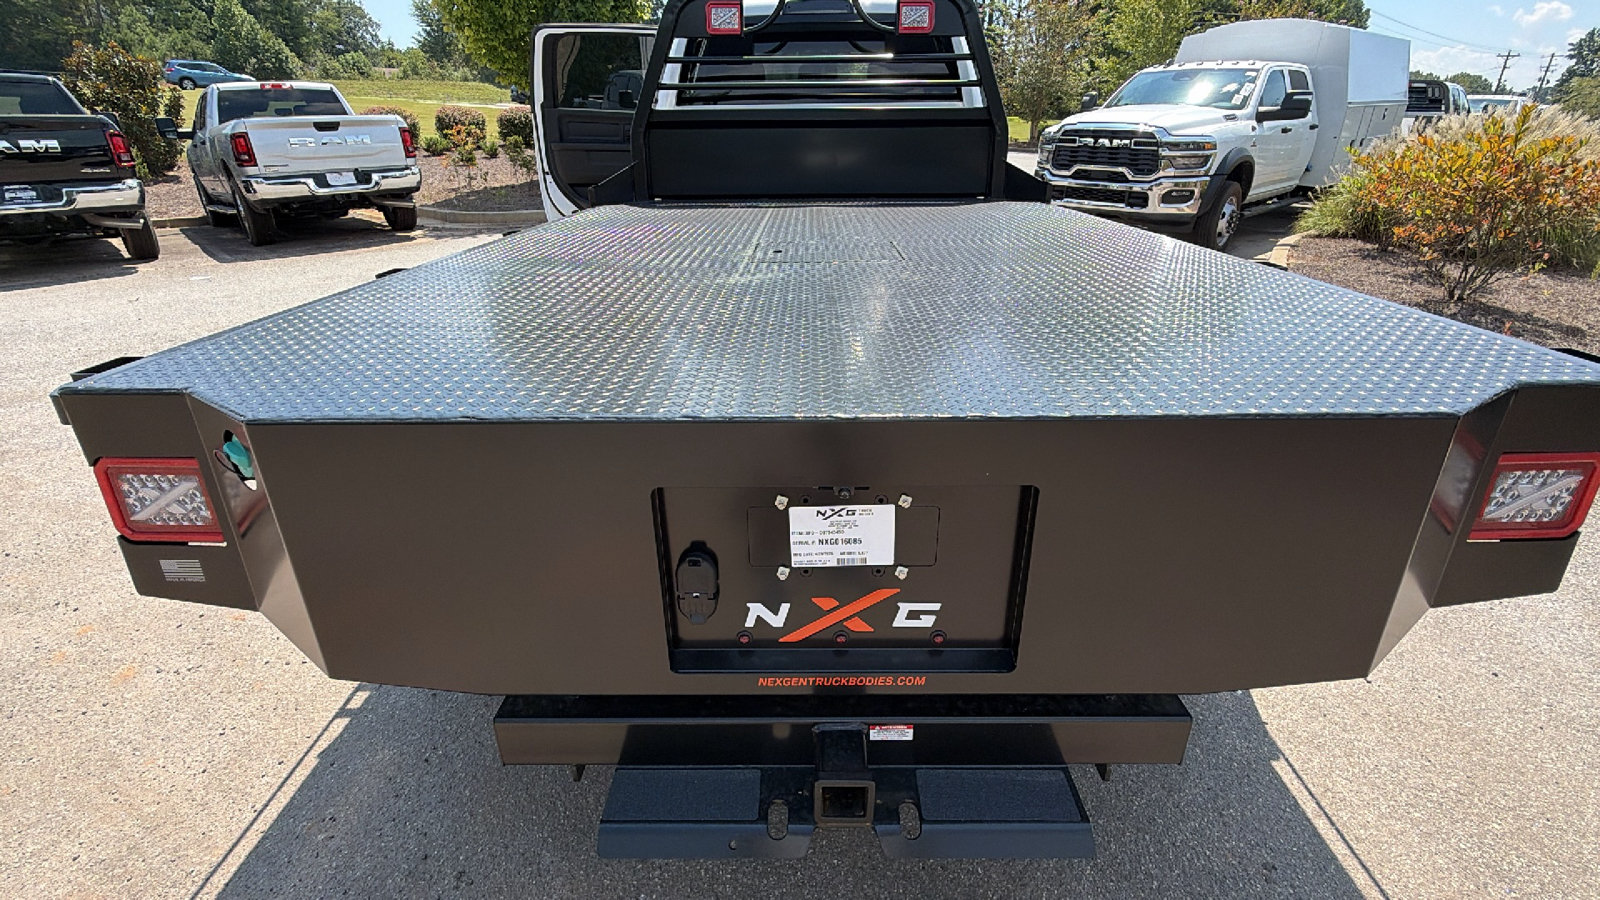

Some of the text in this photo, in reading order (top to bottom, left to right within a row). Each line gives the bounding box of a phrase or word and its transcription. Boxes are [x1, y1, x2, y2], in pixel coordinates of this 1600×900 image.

[288, 135, 371, 148] RAM
[1077, 137, 1131, 148] RAM
[816, 507, 858, 521] NXG
[744, 588, 942, 643] NXG
[757, 675, 927, 687] NEXGENTRUCKBODIES.COM
